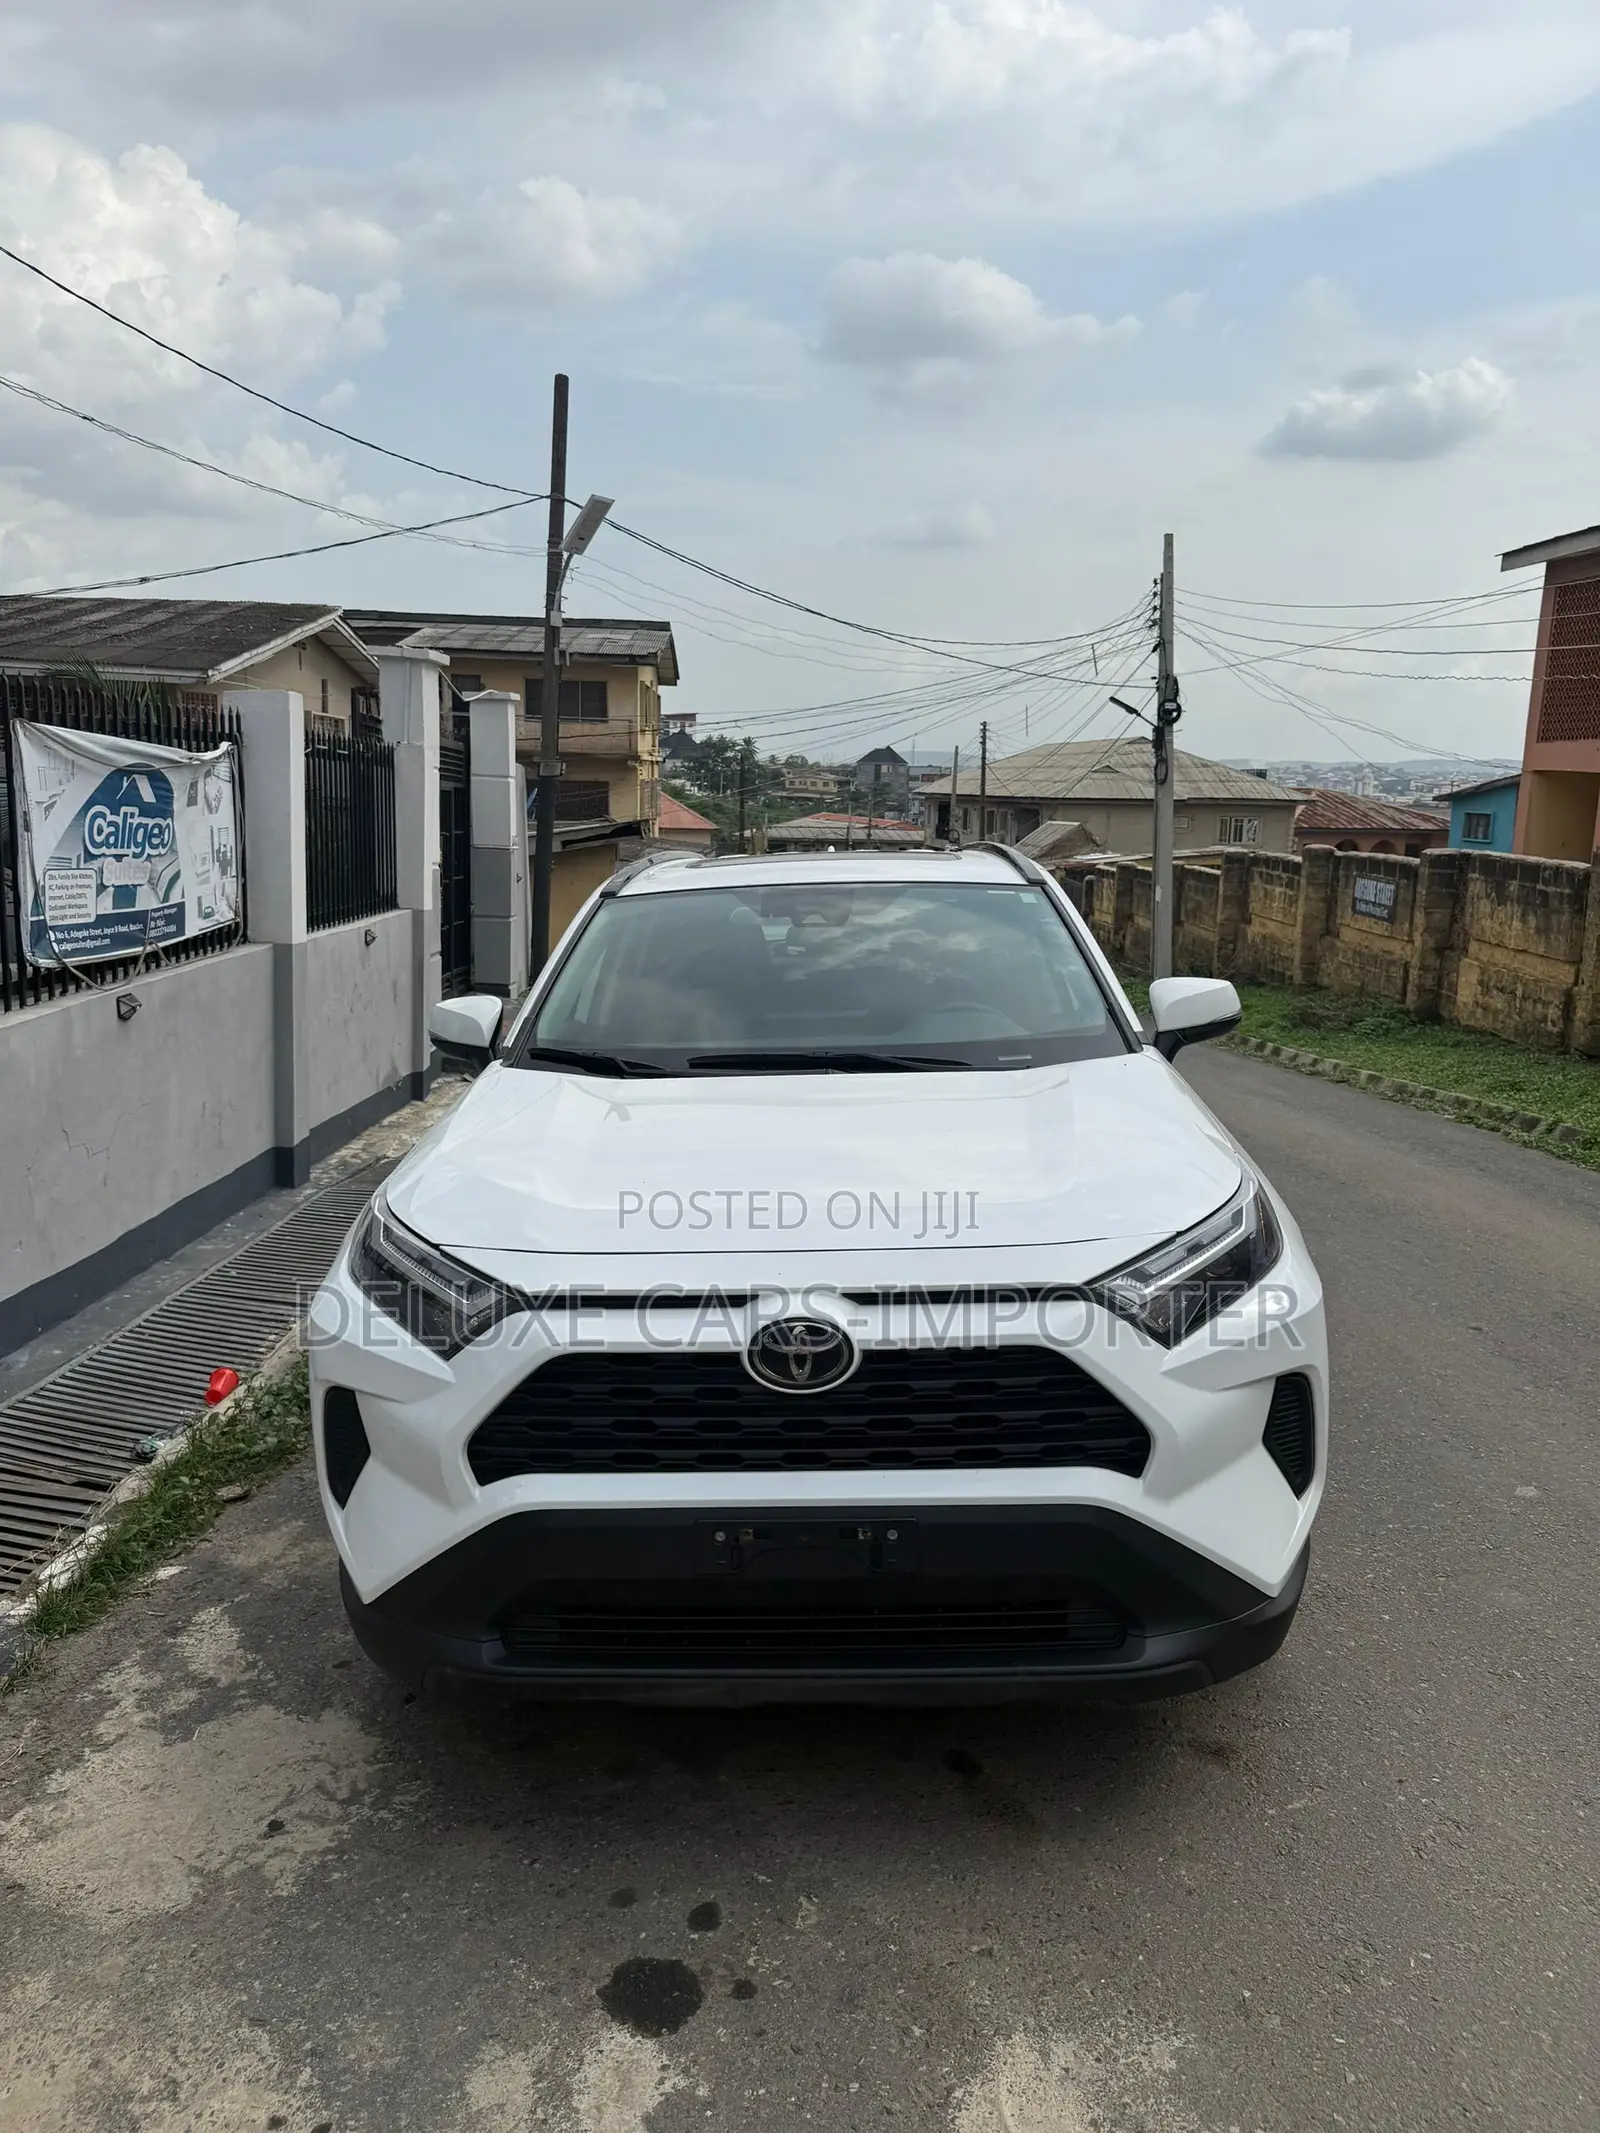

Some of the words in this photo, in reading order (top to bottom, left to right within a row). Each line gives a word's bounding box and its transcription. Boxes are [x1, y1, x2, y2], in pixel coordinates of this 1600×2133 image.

[86, 808, 171, 860] Caligeo
[105, 857, 148, 880] Suites
[56, 930, 65, 939] No
